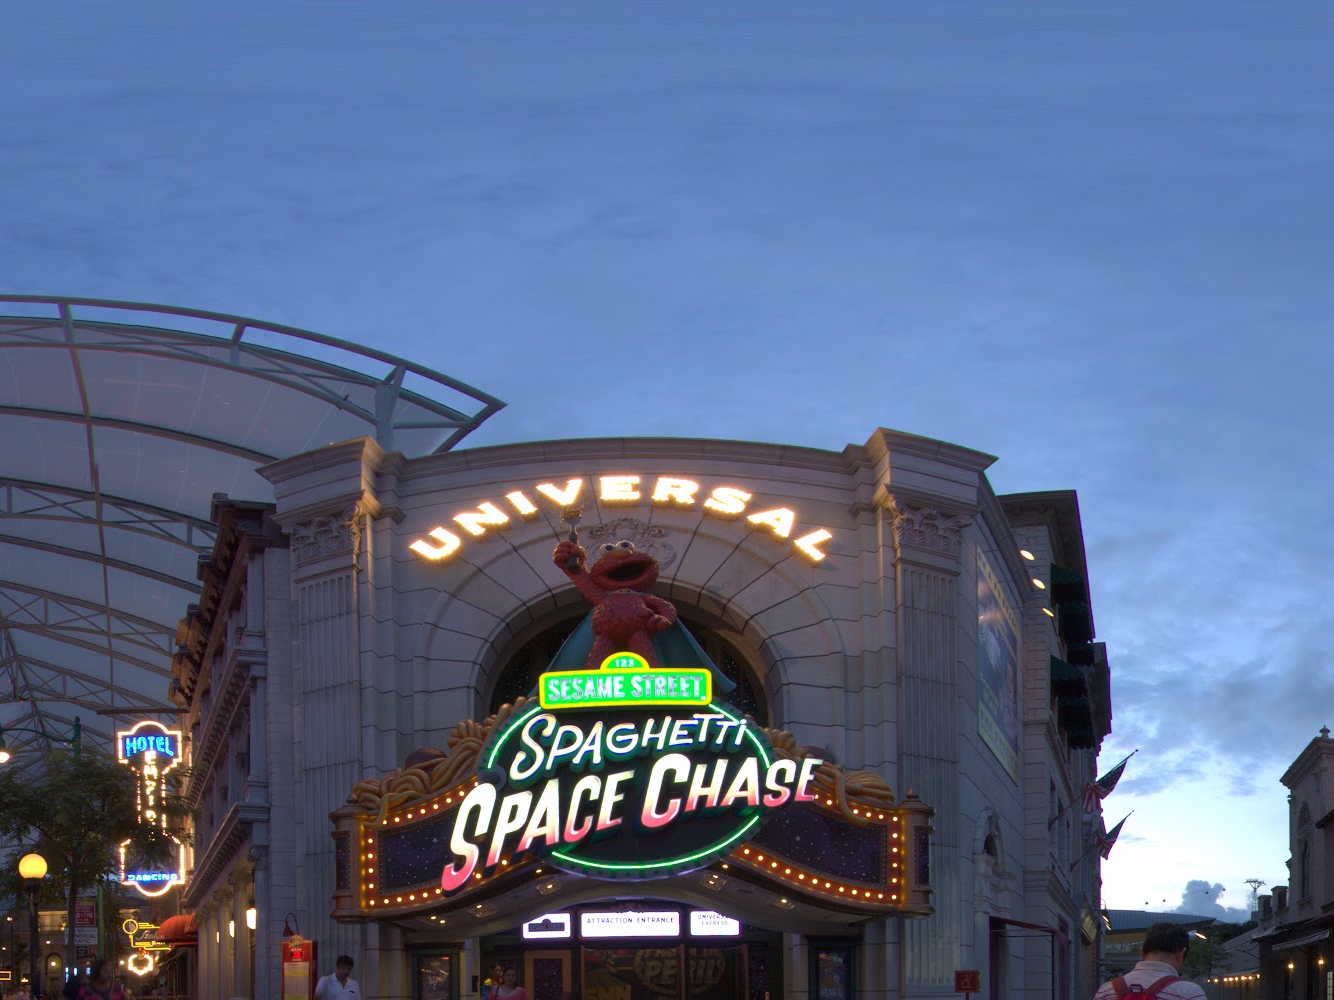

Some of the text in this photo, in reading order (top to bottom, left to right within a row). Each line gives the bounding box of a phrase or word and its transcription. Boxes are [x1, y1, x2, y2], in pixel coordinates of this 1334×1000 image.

[409, 475, 832, 561] UNIVERSAL
[615, 659, 635, 667] 123
[548, 675, 703, 700] SESAME STREET
[125, 736, 174, 757] HOTEL
[510, 712, 747, 781] SPAGHETTI
[441, 753, 823, 892] SPACE CHASE
[127, 873, 178, 882] DANCING
